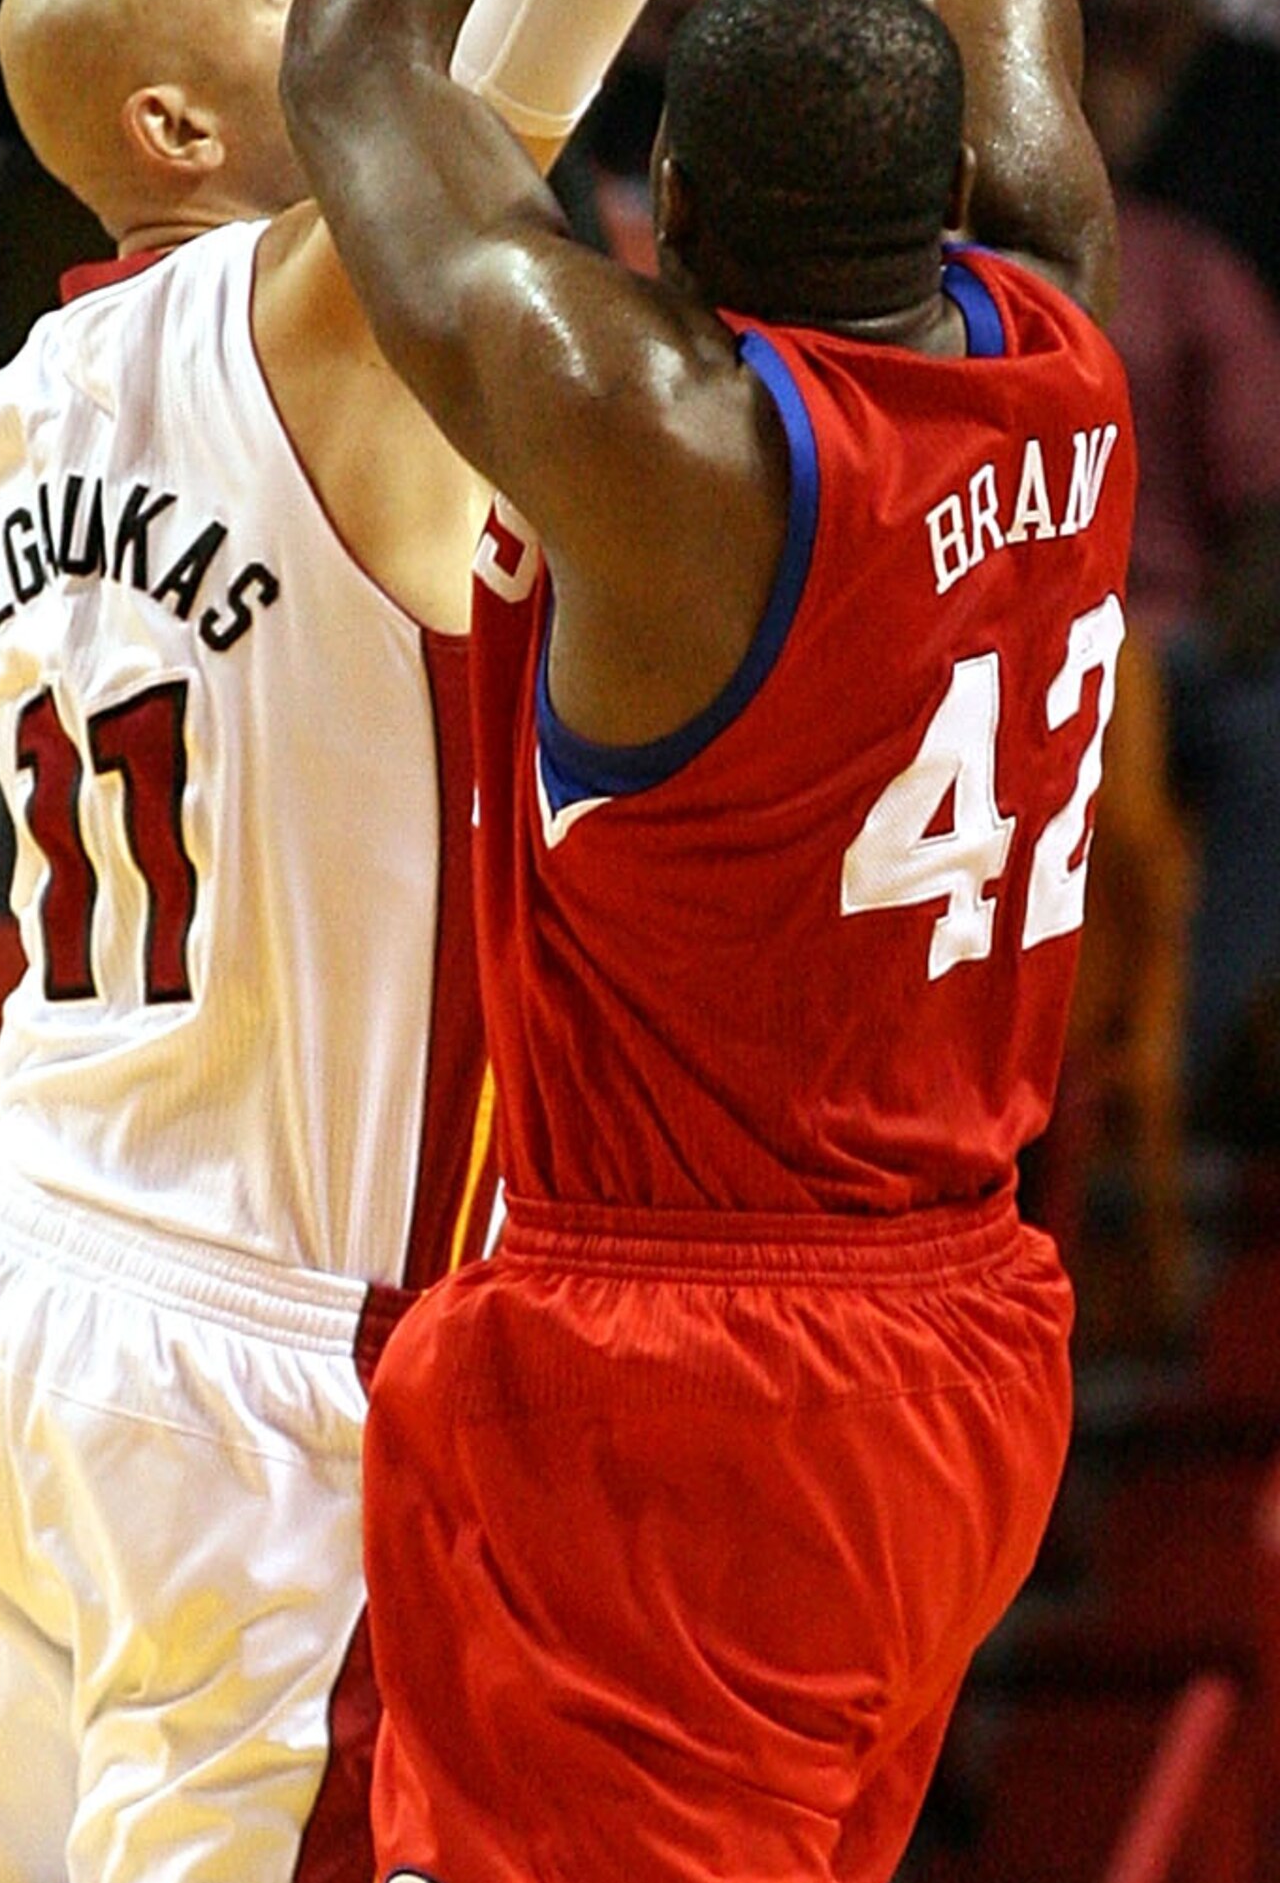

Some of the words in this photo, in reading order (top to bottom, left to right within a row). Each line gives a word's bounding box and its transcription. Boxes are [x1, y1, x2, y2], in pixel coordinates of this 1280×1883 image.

[924, 422, 1119, 596] BRAN
[14, 676, 199, 1005] 11
[839, 592, 1126, 982] 42
